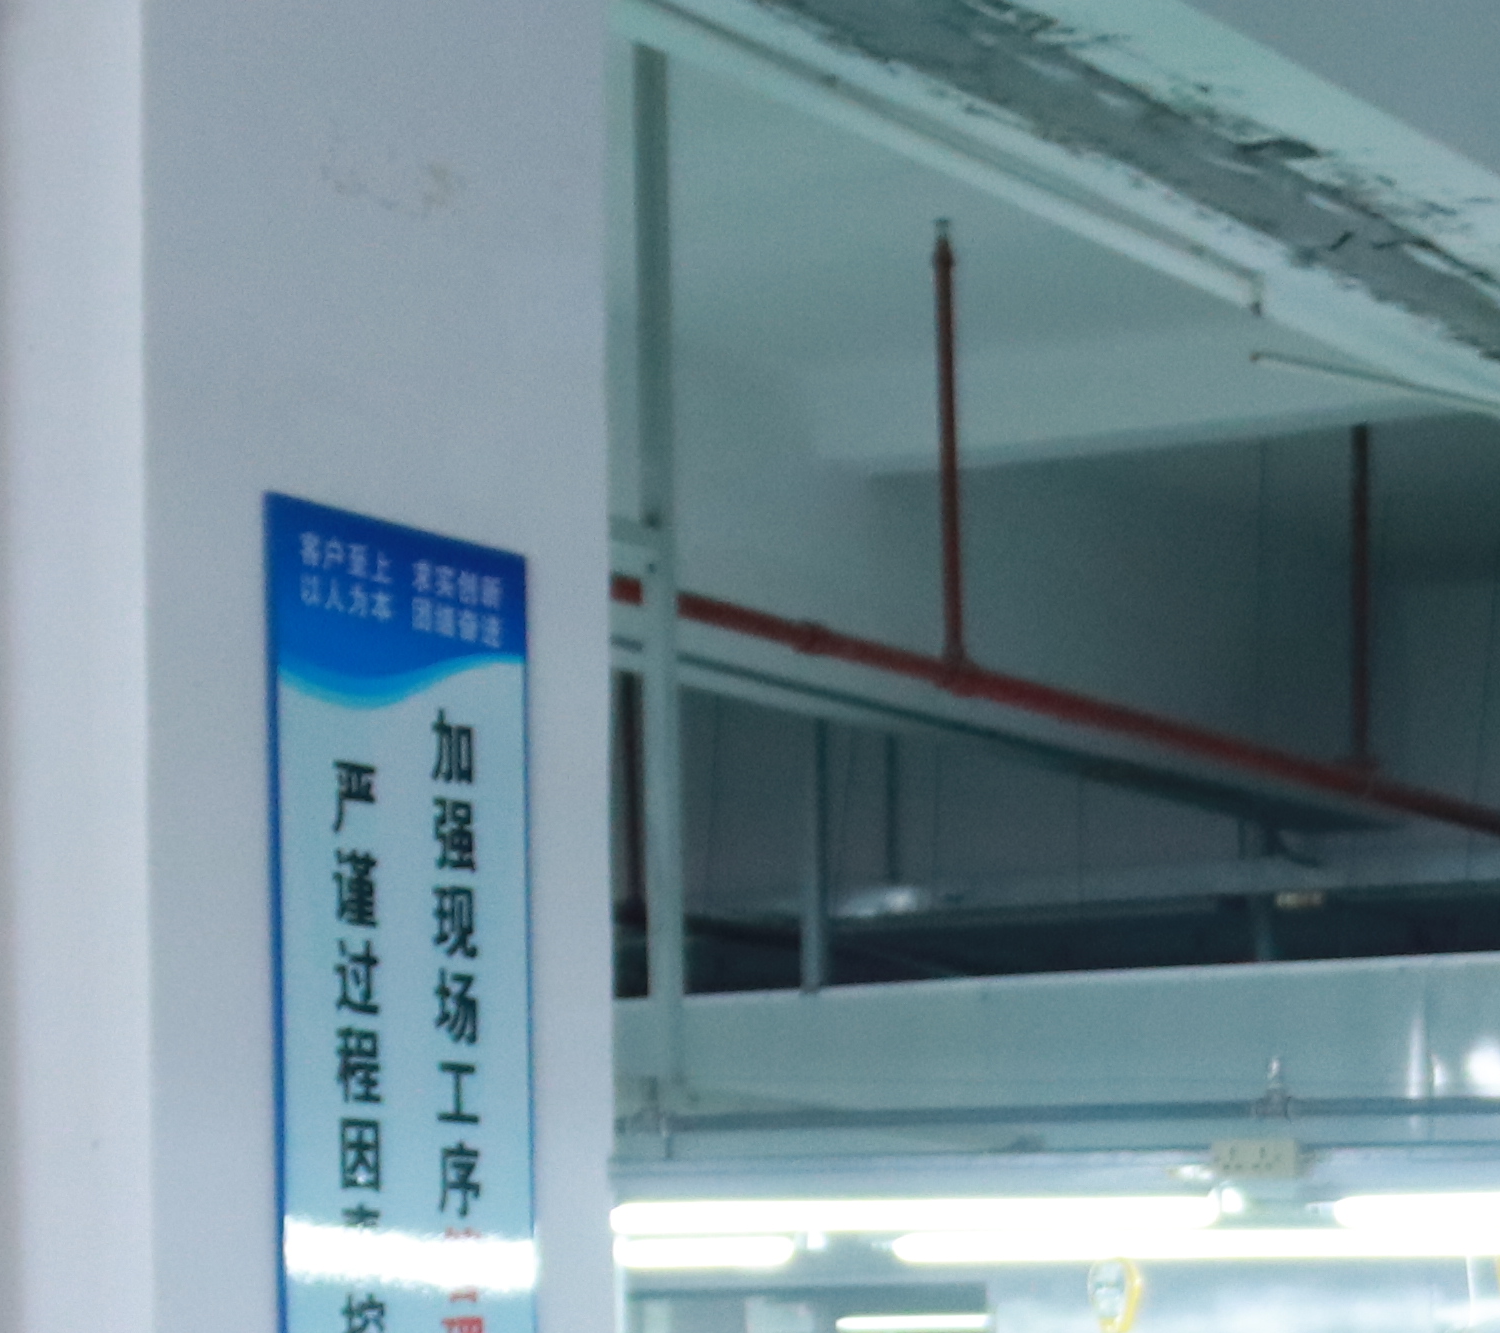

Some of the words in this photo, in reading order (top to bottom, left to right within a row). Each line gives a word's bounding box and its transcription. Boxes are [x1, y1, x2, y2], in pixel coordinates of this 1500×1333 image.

[300, 531, 393, 584] 客户至上
[300, 574, 393, 622] 以人为本
